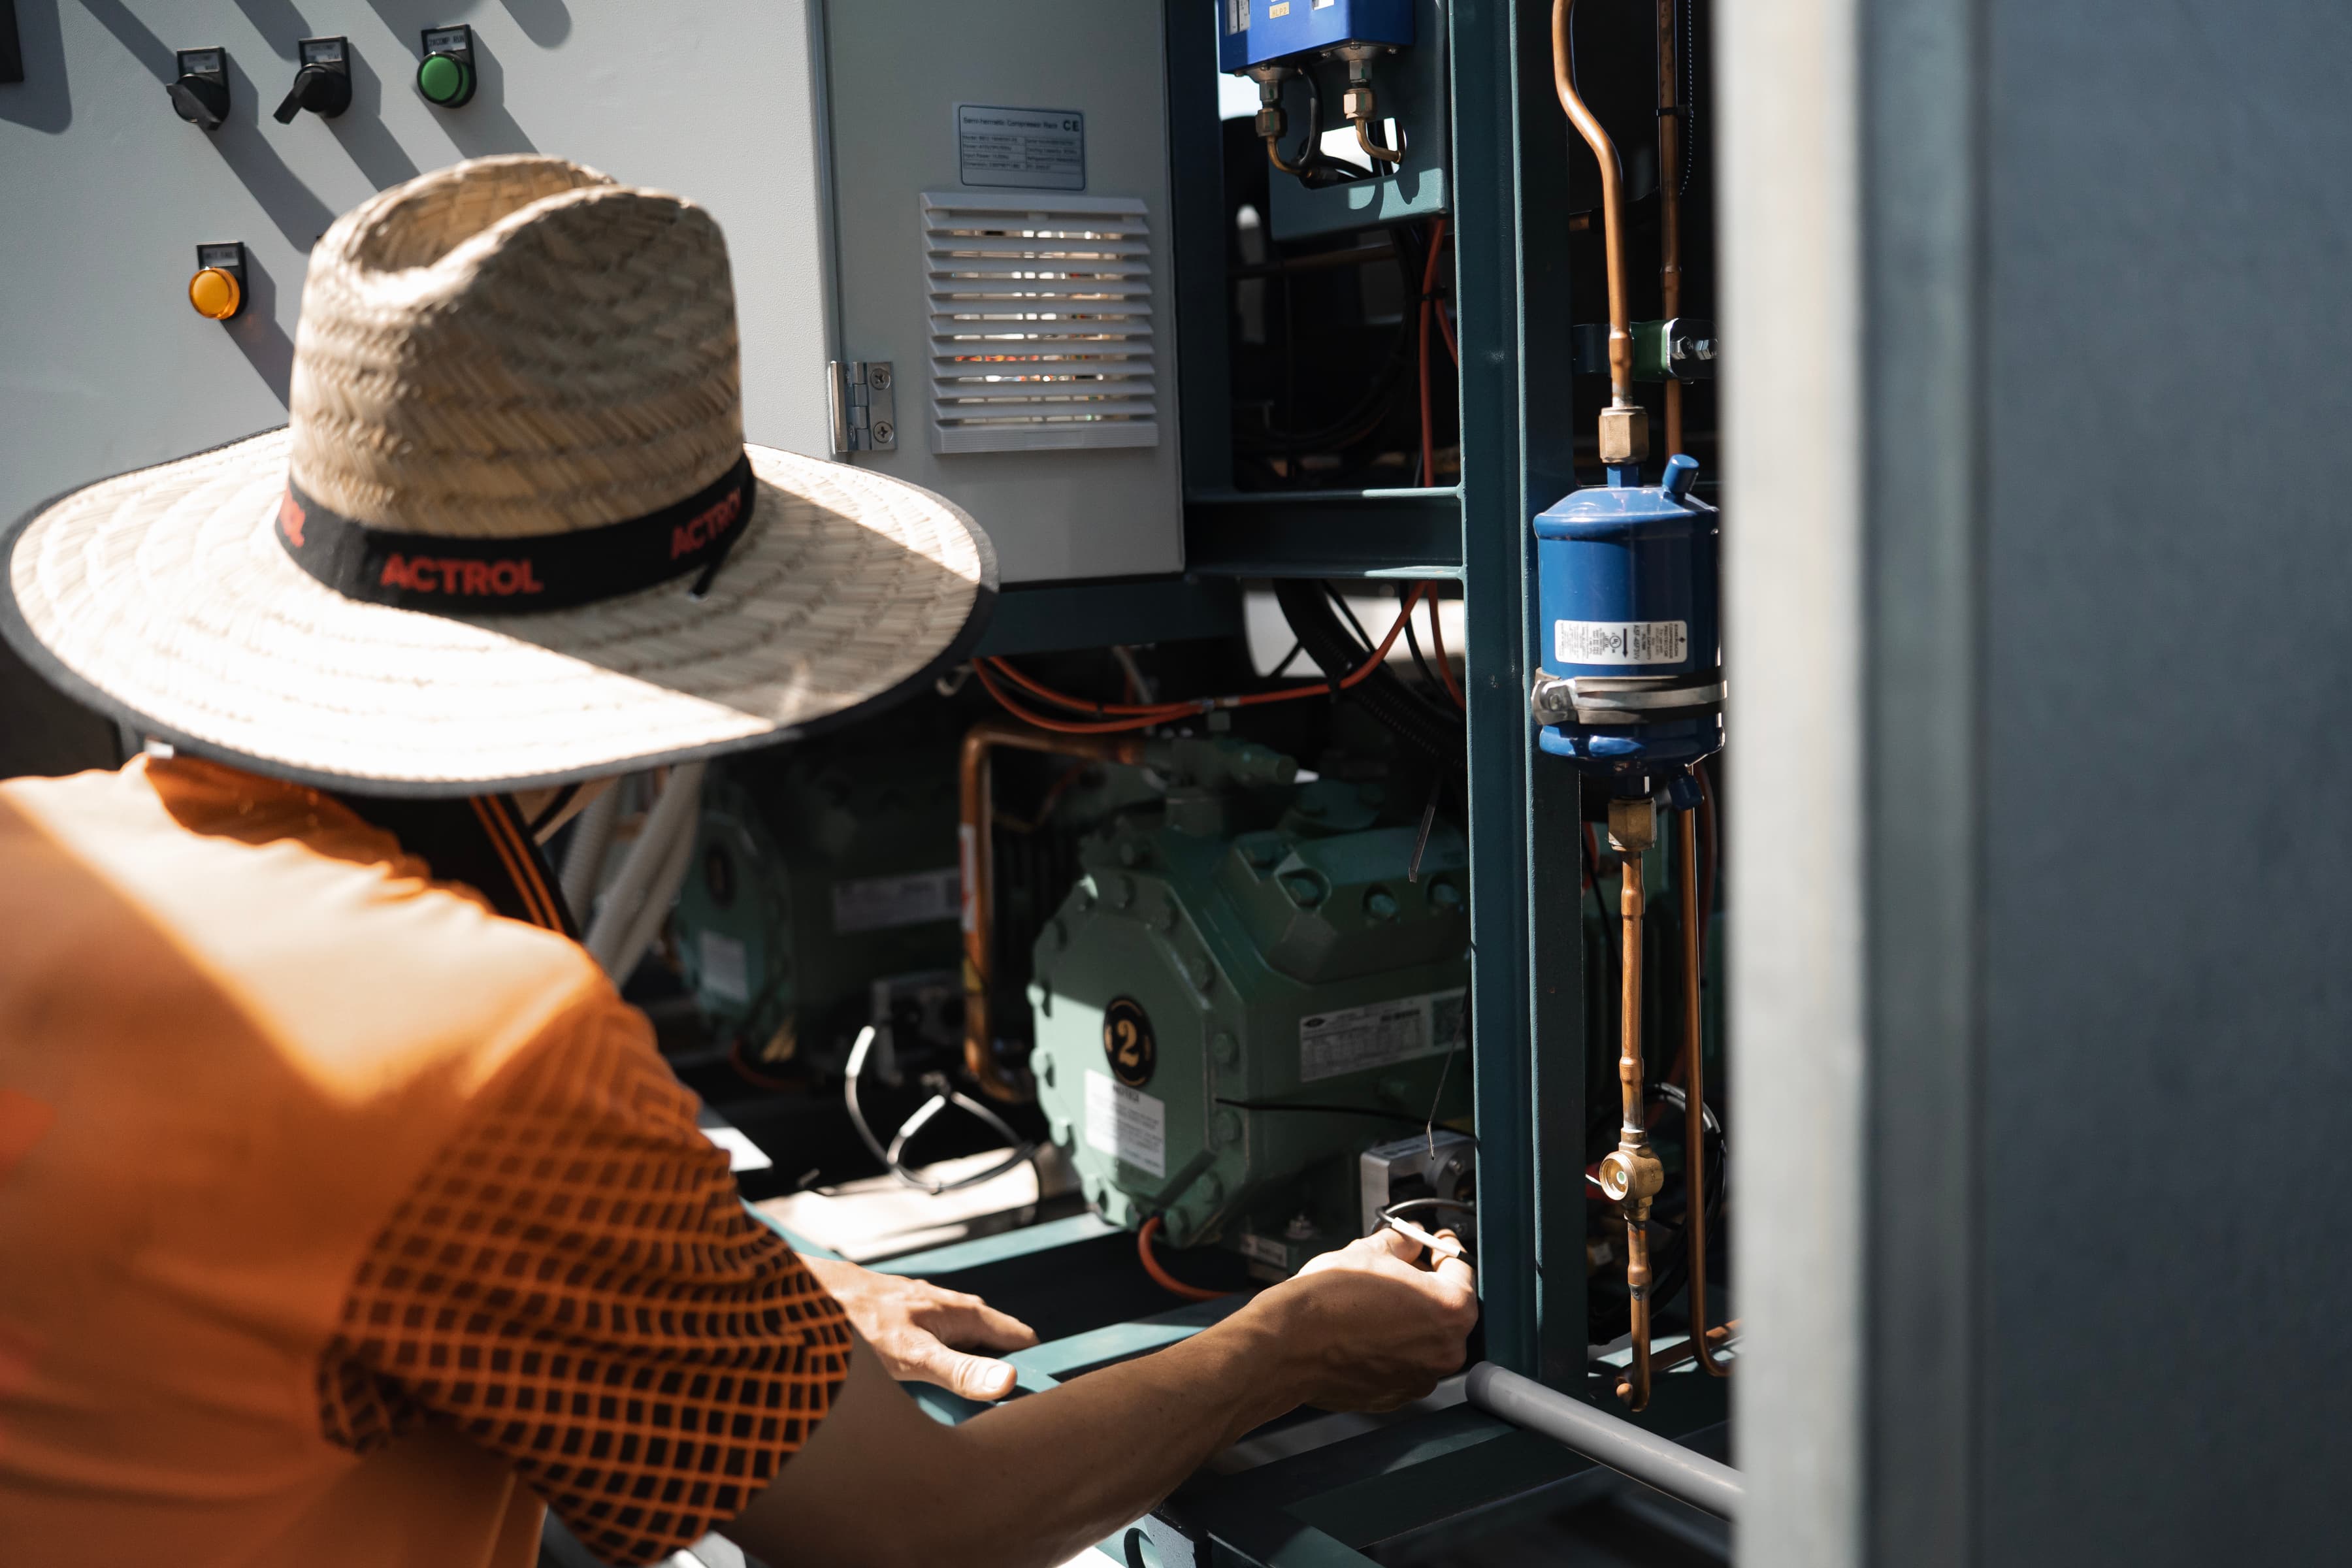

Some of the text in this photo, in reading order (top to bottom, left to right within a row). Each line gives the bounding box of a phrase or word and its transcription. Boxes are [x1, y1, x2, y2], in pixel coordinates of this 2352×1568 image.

[1064, 120, 1080, 132] CE
[671, 487, 741, 561] ACTRO
[381, 553, 543, 596] ACTROL
[1117, 1020, 1139, 1066] 2
